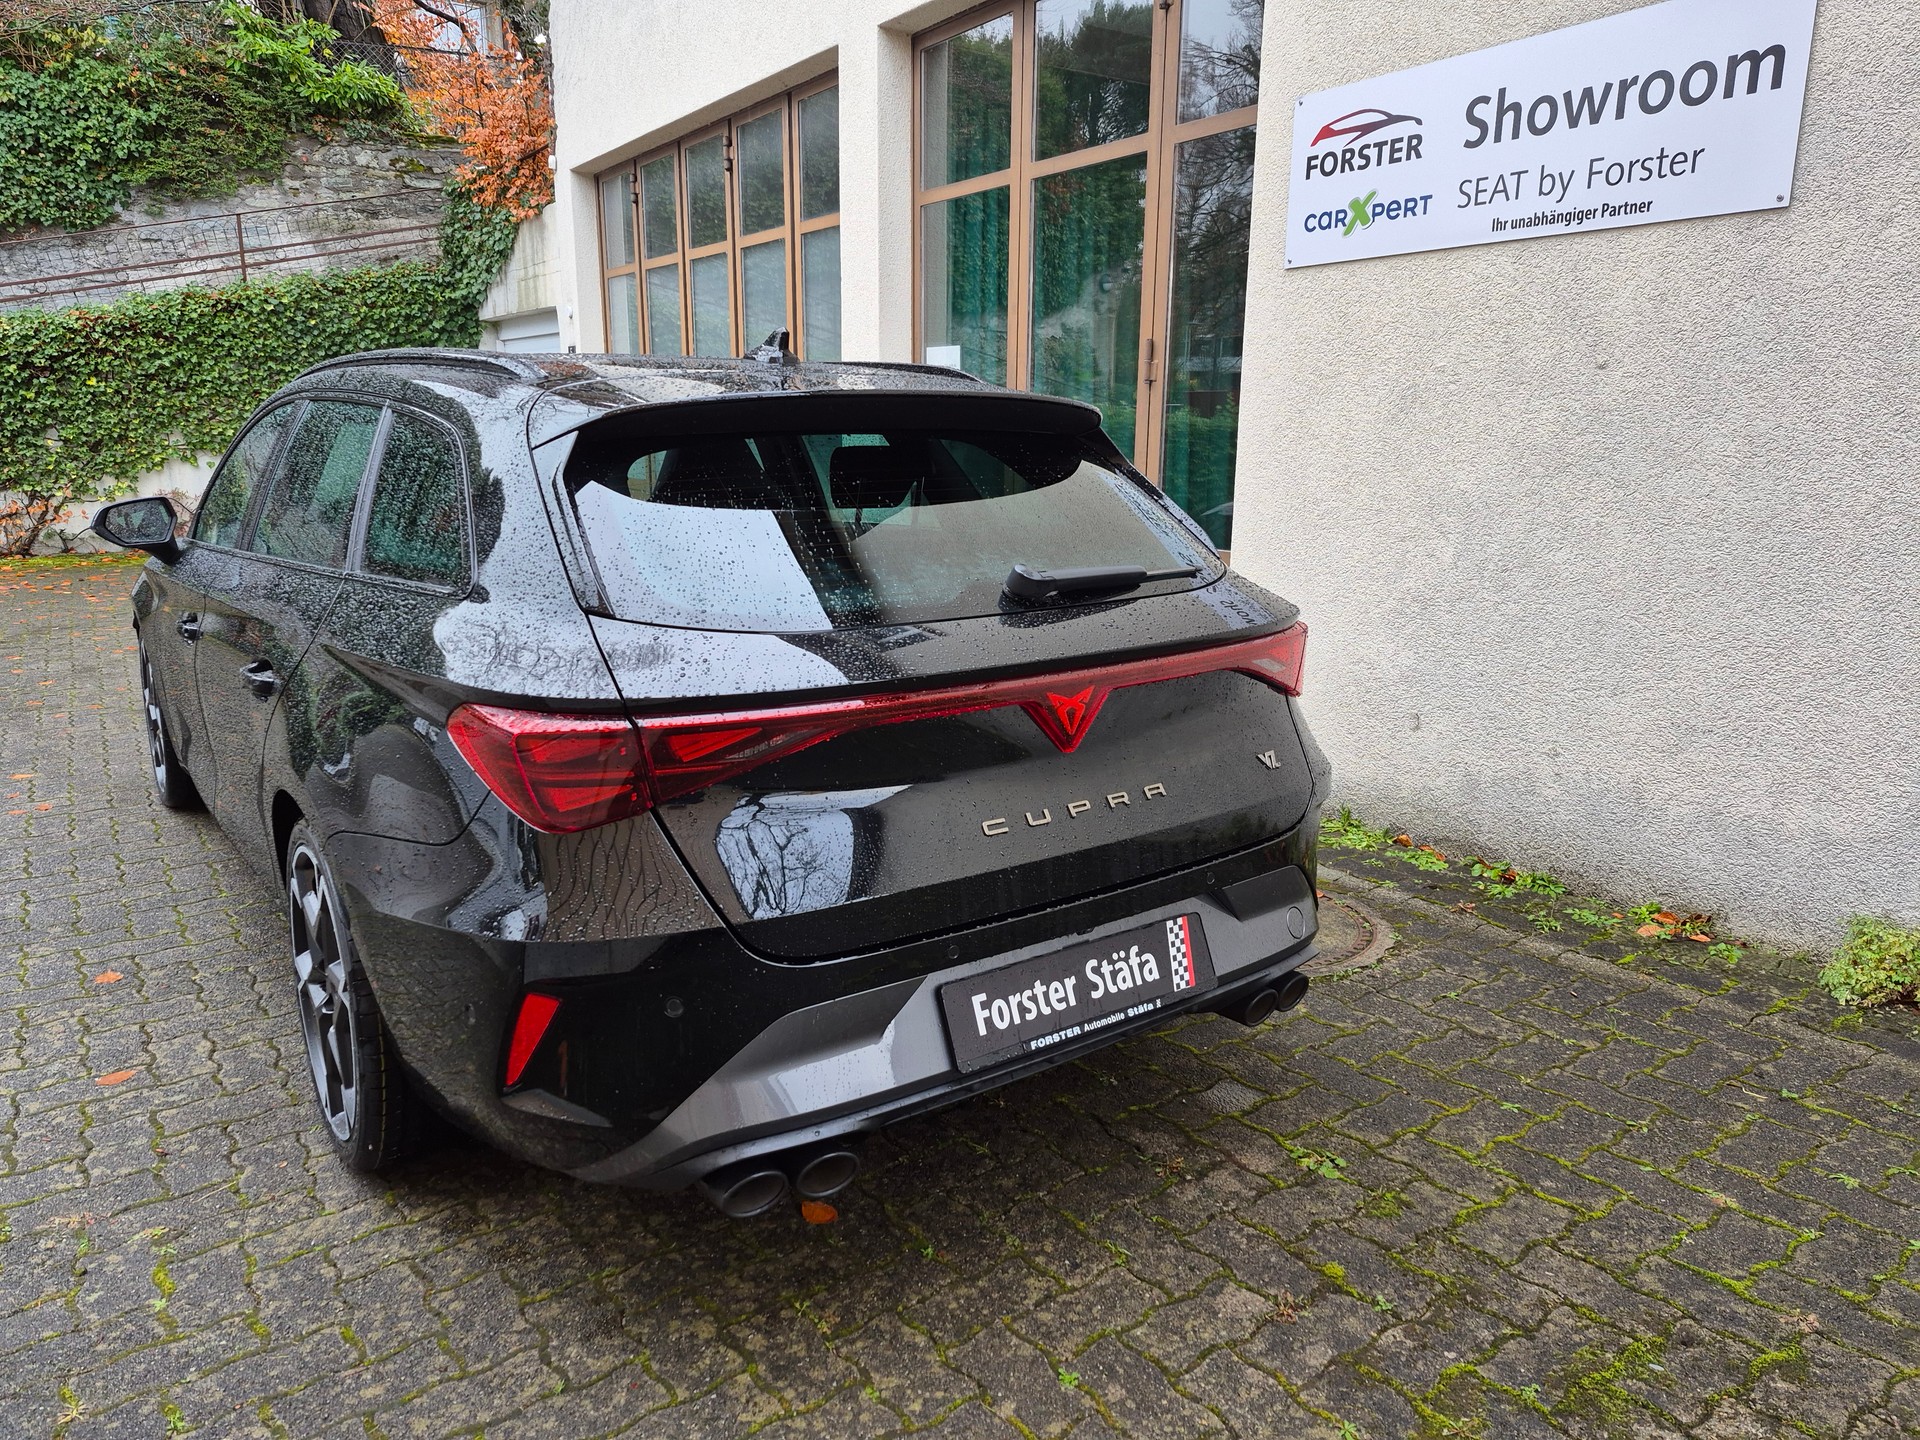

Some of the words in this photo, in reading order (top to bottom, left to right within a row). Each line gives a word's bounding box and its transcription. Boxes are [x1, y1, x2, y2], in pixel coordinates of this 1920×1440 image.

[1463, 43, 1786, 149] Showroom
[1305, 133, 1423, 181] FORSTER
[1457, 169, 1529, 209] SEAT
[1538, 164, 1576, 204] by
[1586, 146, 1706, 190] Forster
[1491, 217, 1510, 233] Ihr
[1510, 207, 1599, 230] unabhängiger
[1600, 200, 1654, 219] Partner
[981, 782, 1168, 836] CUPRA
[971, 975, 1077, 1037] Forster
[1085, 944, 1161, 999] Stäfa
[1030, 1025, 1082, 1051] FORSTER
[1084, 1012, 1126, 1033] Automobile
[1126, 1002, 1155, 1018] Stäfa
